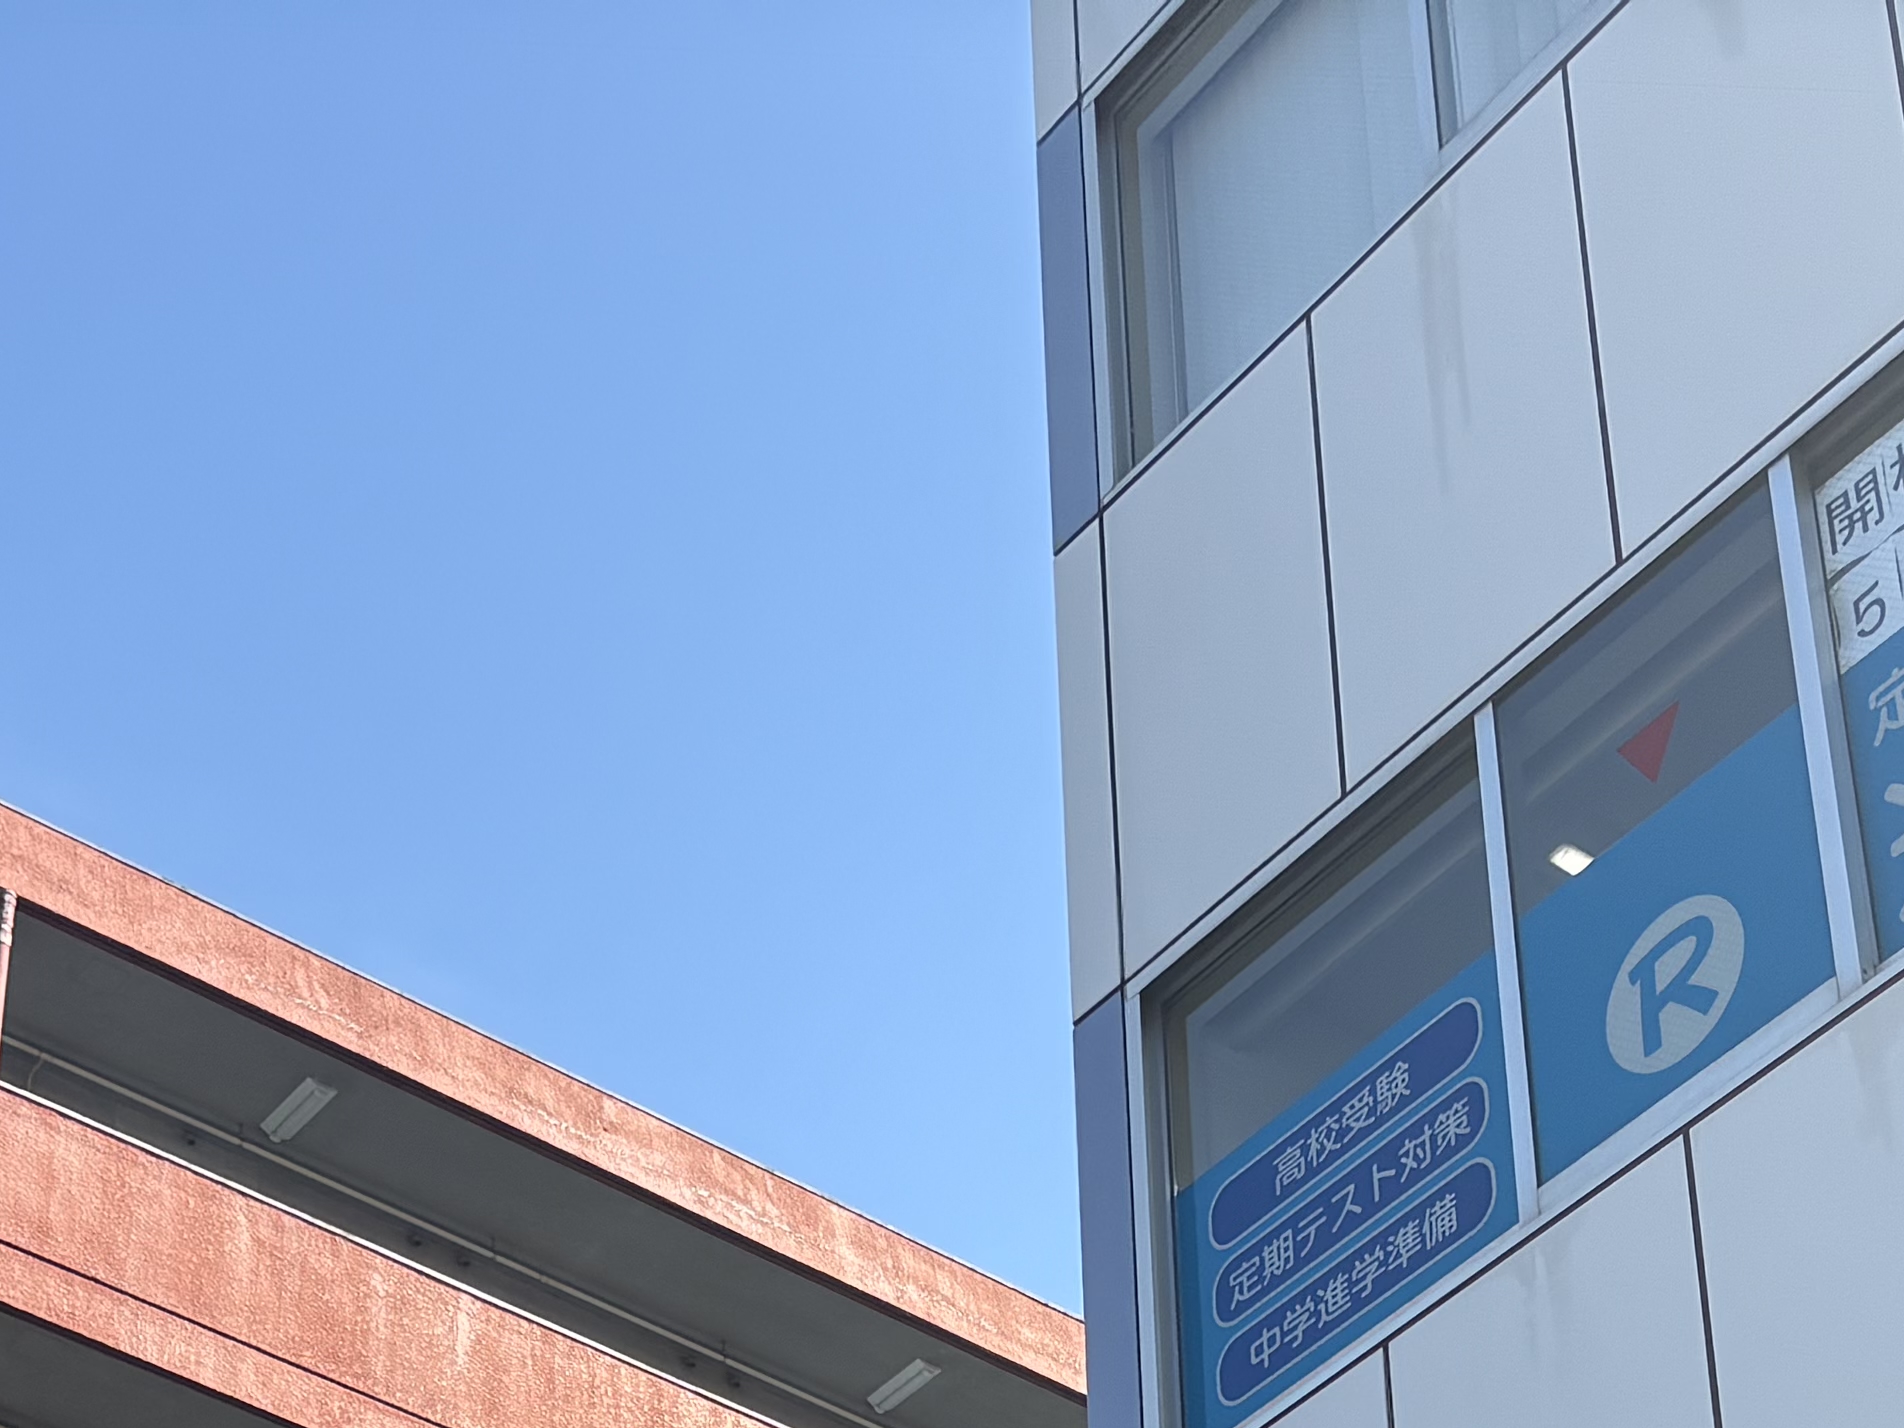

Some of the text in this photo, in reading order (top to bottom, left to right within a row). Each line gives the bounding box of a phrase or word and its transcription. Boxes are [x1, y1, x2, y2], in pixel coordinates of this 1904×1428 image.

[1228, 1096, 1473, 1312] 定期テスト対策
[1272, 1059, 1412, 1197] 高校受験
[1249, 1192, 1459, 1372] 中学進学準備
